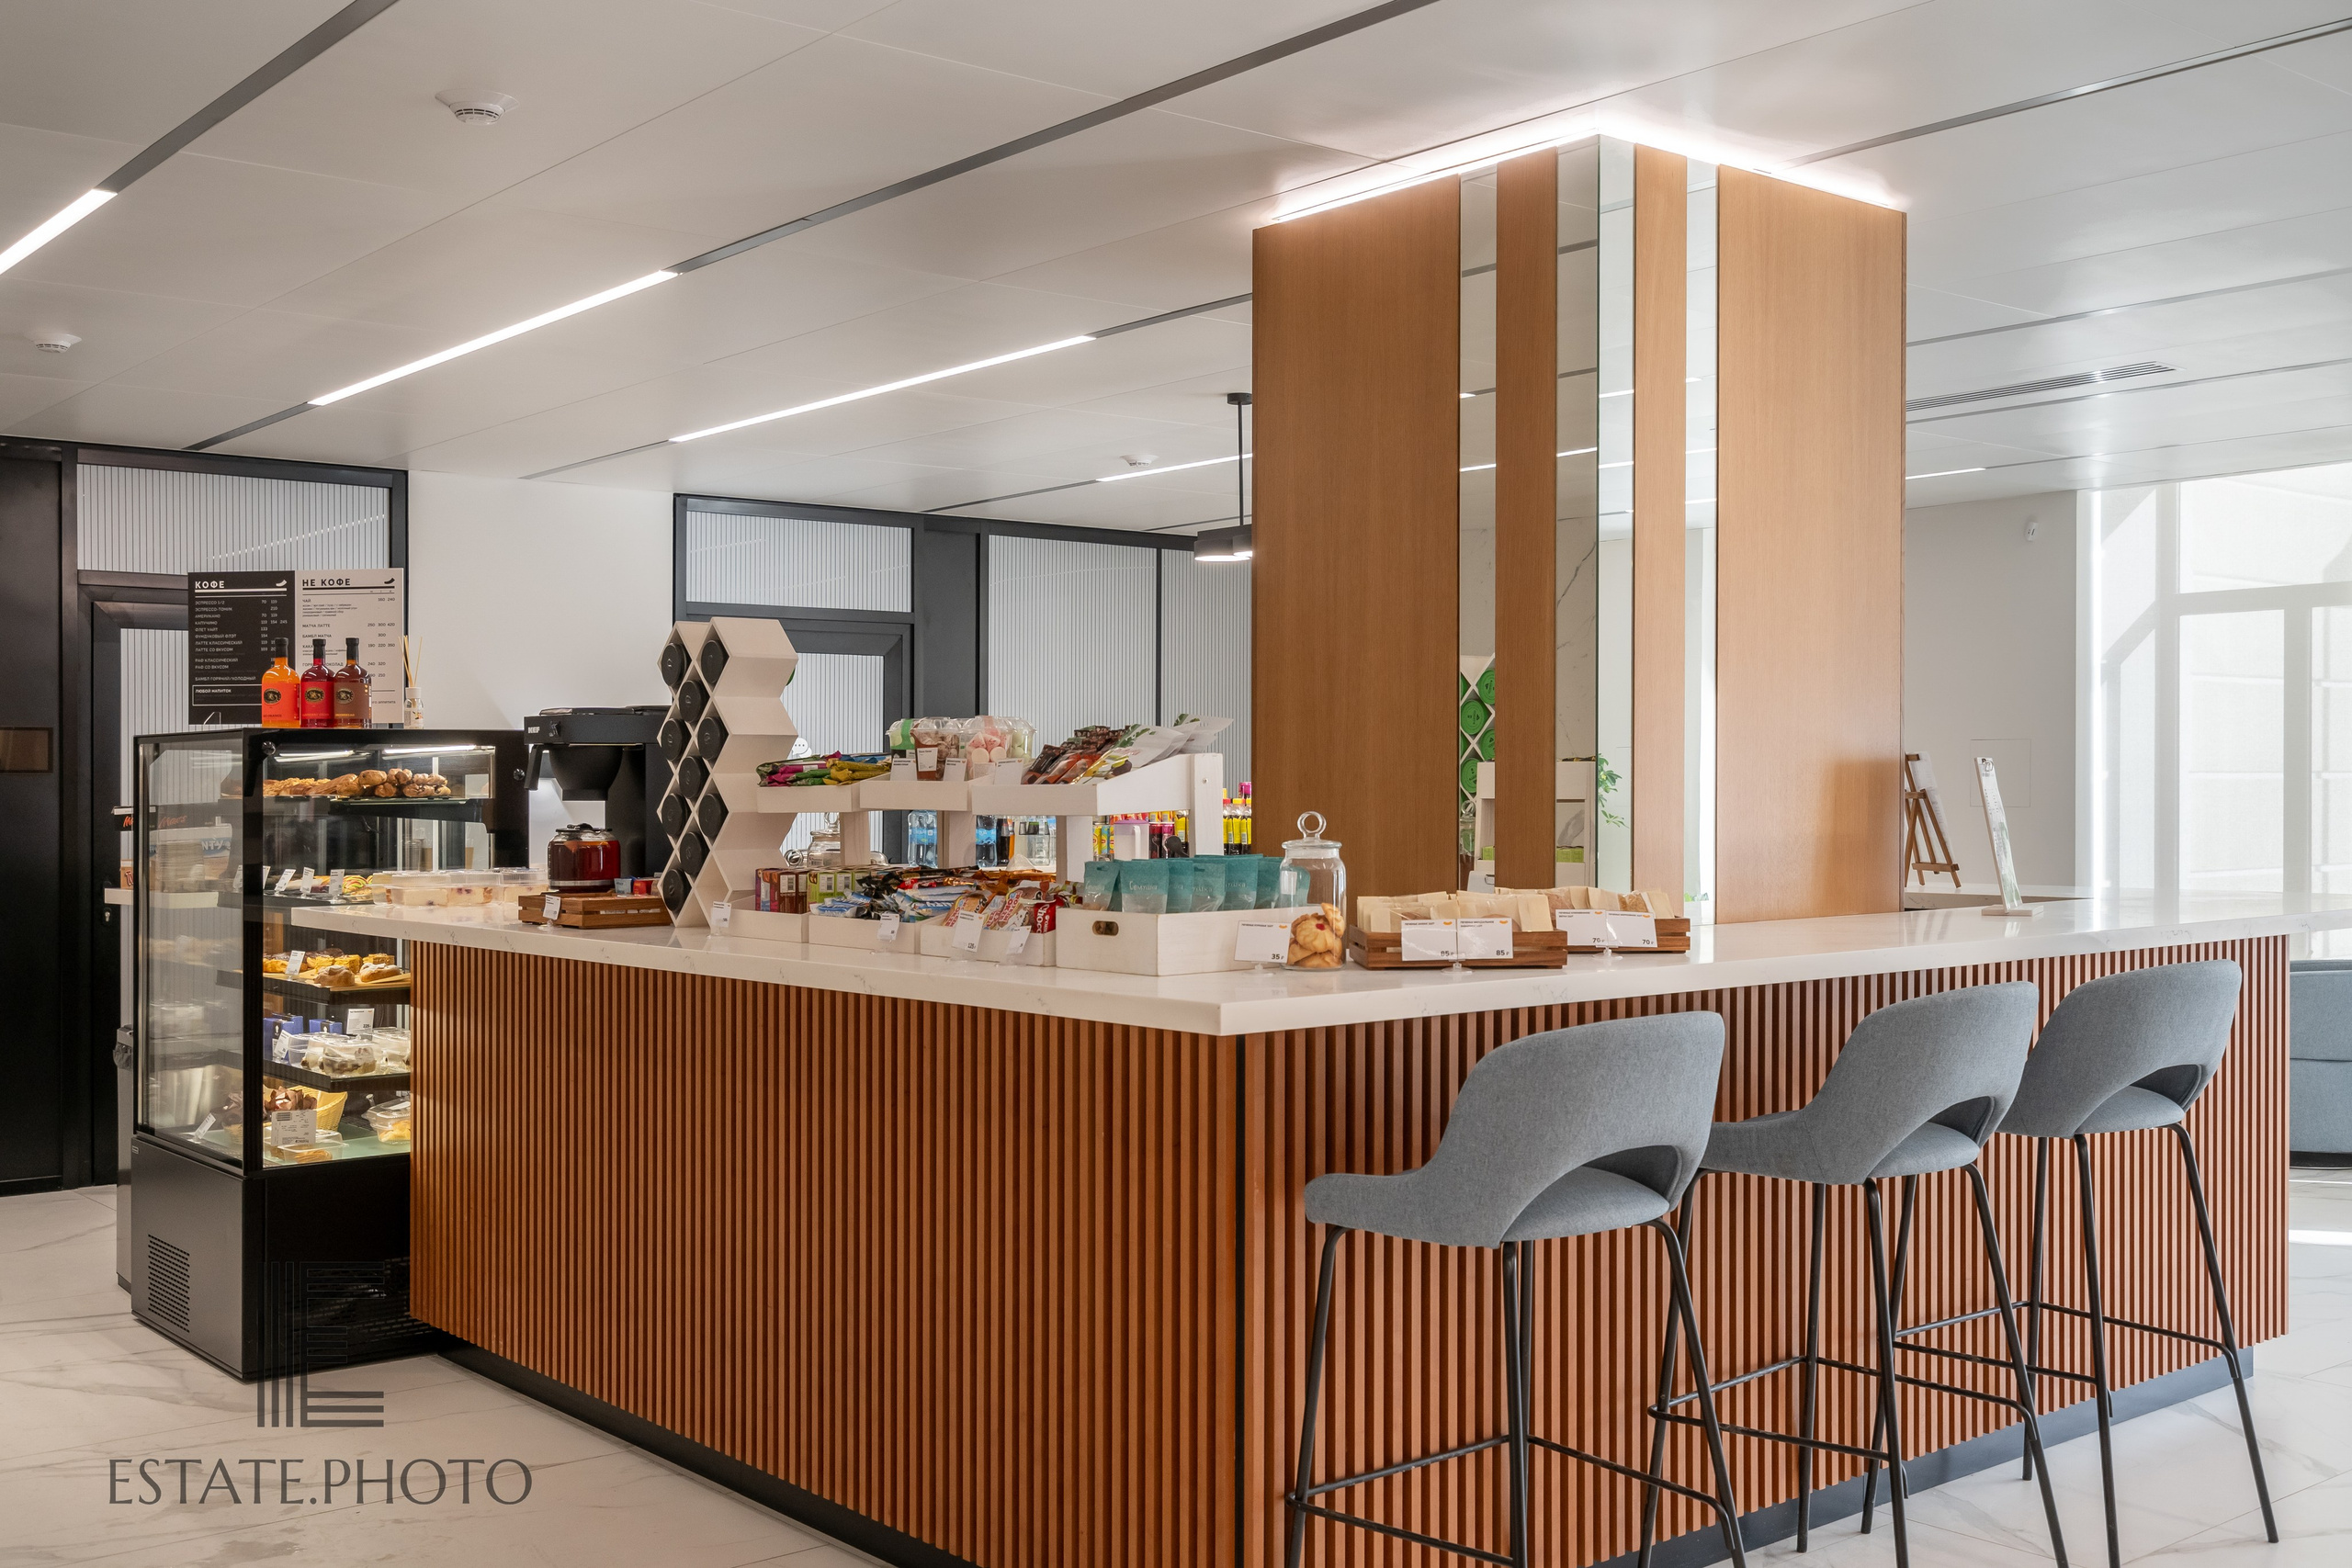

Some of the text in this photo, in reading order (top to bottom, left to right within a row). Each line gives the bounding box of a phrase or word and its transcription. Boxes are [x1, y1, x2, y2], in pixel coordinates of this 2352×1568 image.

[195, 581, 225, 589] КОФЕ
[302, 578, 351, 587] НЕ КОФЕ
[157, 815, 187, 829] Mars
